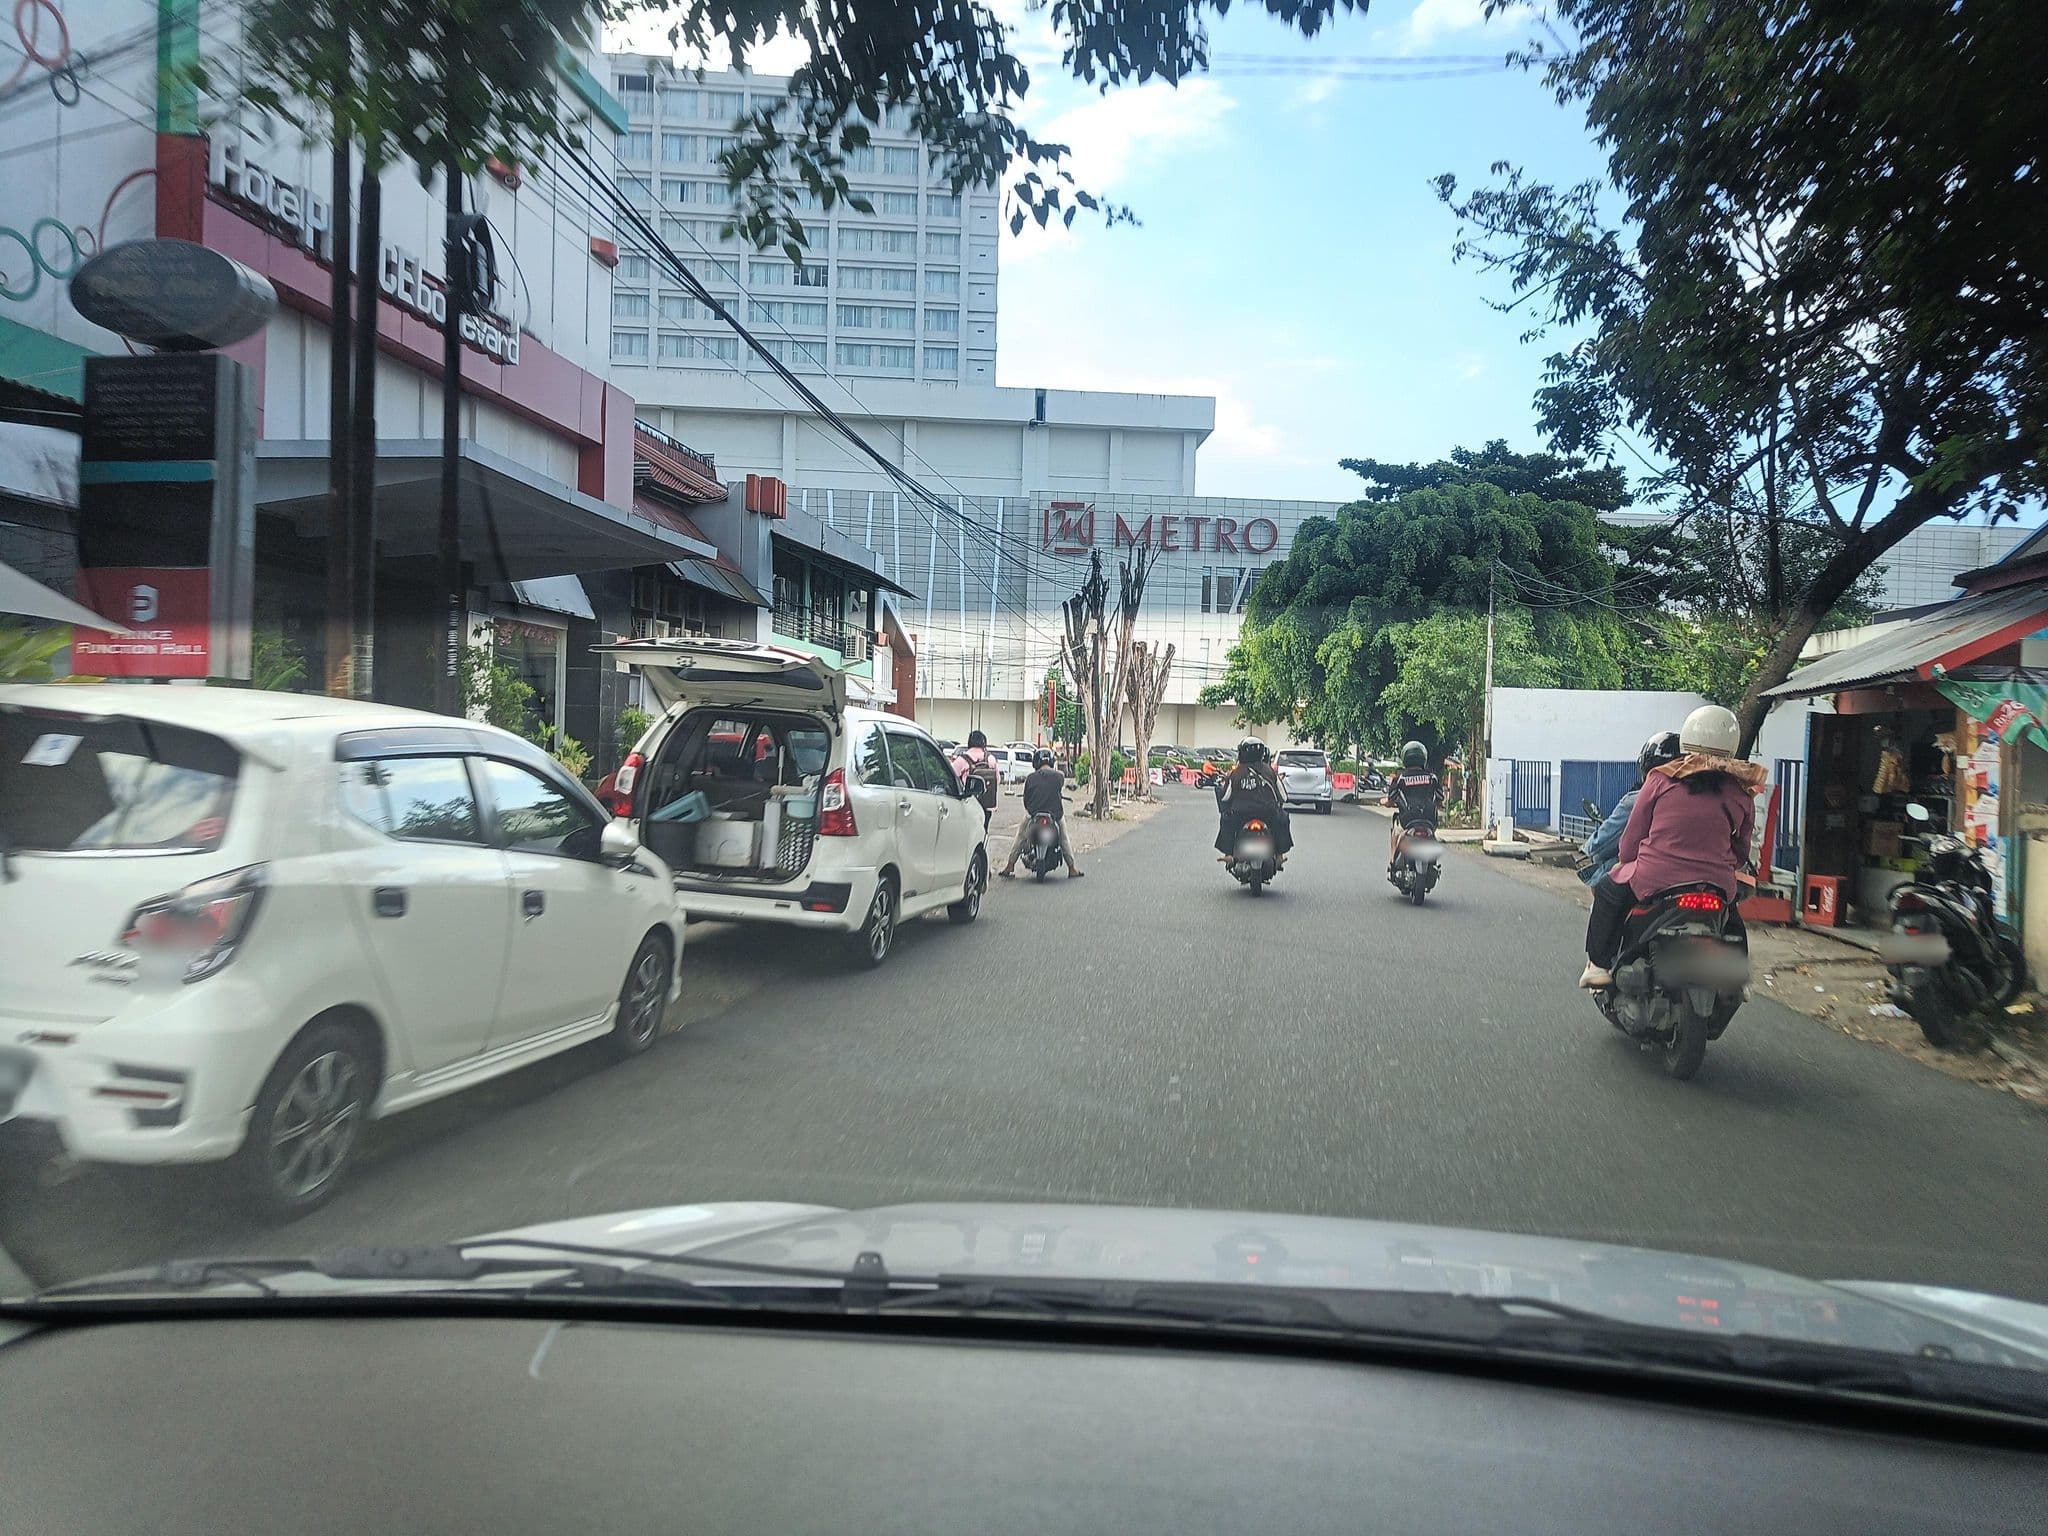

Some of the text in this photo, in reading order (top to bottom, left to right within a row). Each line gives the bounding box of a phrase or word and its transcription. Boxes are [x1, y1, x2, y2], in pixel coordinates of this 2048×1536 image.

[208, 135, 305, 232] Hotel
[416, 257, 519, 366] boevard
[1115, 513, 1278, 554] METRO
